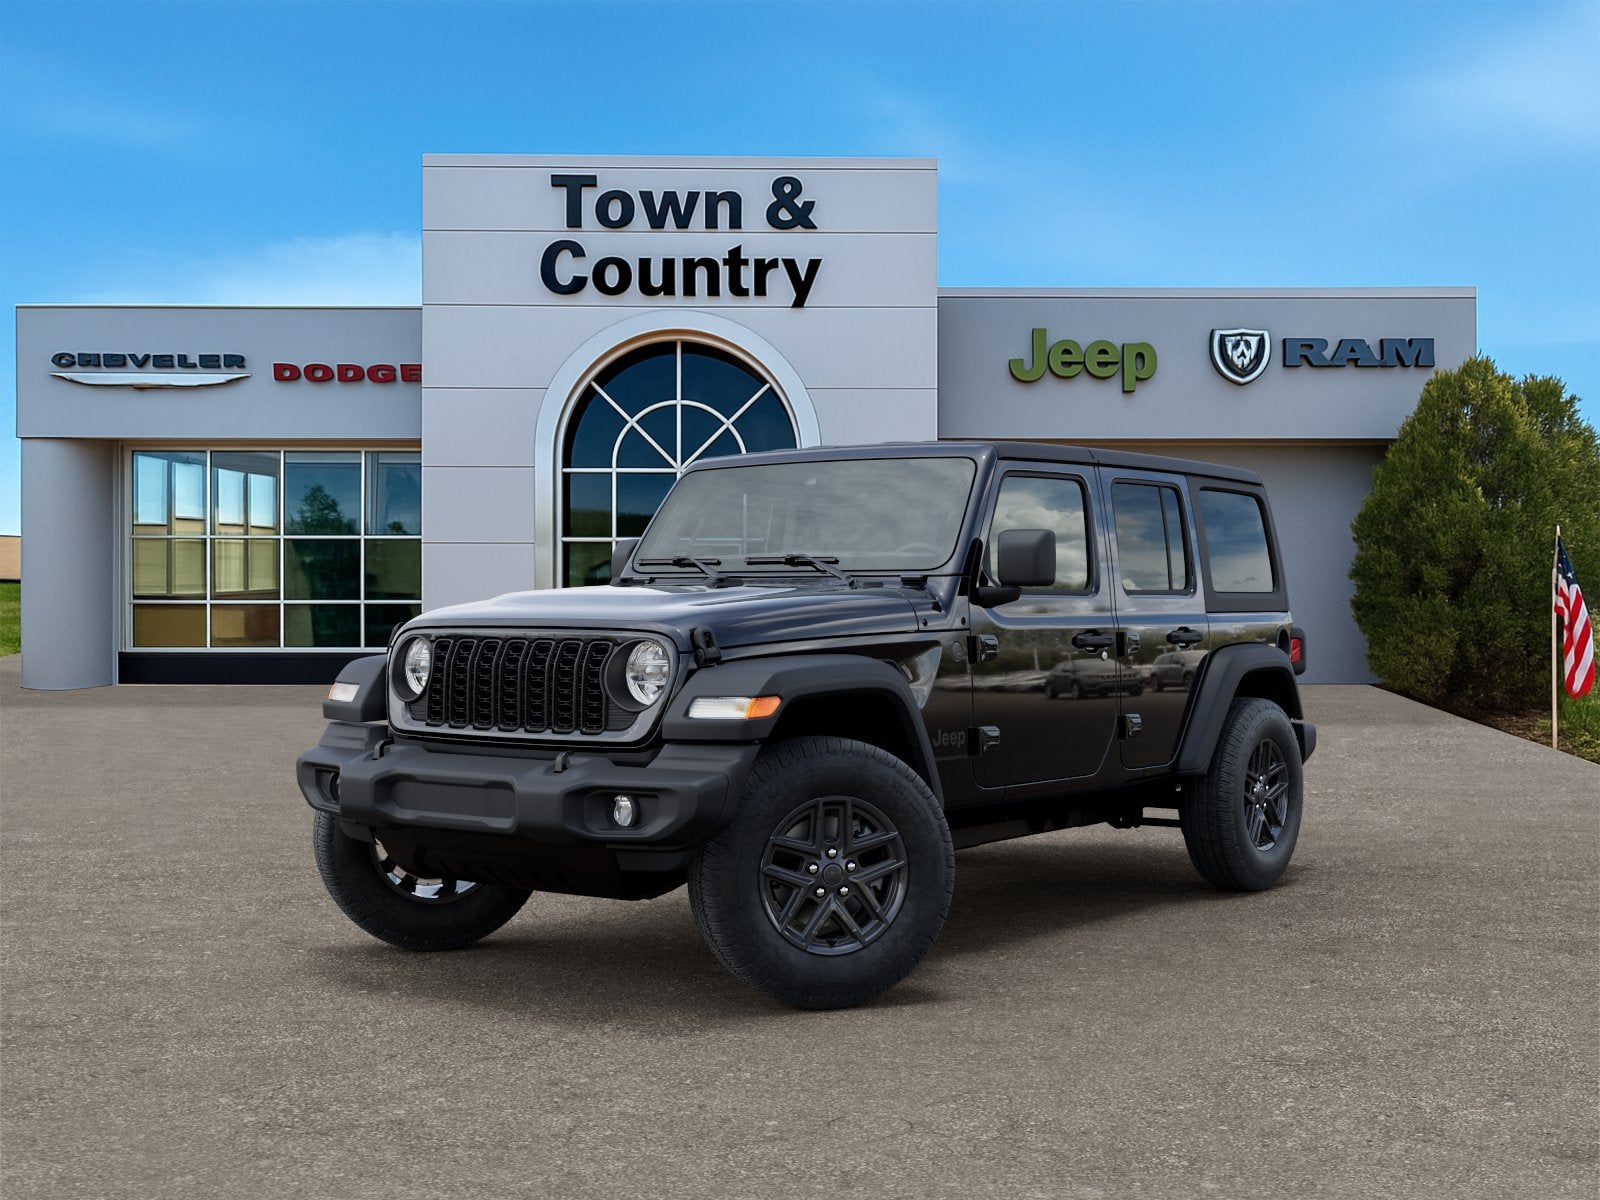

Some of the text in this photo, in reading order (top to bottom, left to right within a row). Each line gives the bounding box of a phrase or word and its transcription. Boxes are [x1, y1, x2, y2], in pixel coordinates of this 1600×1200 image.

[550, 174, 818, 230] Town &
[540, 239, 822, 308] Country
[273, 363, 422, 383] DODGE
[1009, 328, 1157, 392] Jeep
[1282, 337, 1436, 368] RAM
[932, 728, 966, 748] Jeep
